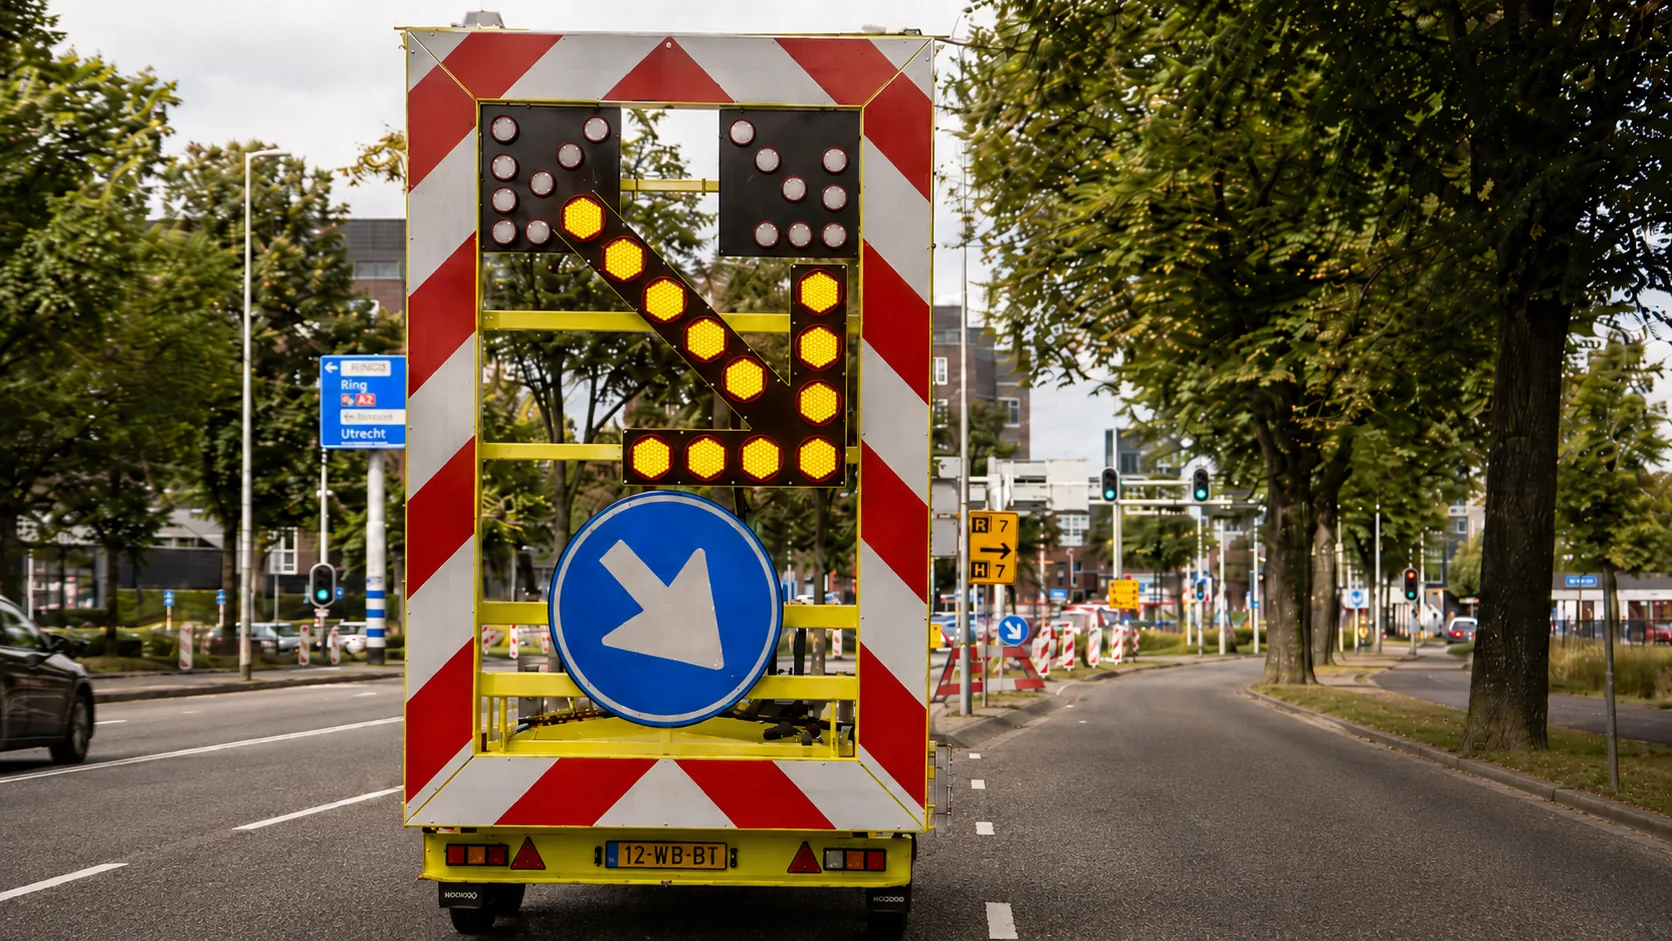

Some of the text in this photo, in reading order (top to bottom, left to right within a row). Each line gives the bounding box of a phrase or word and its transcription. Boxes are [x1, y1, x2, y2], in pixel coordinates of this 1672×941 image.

[341, 380, 367, 393] Ring
[358, 396, 374, 405] A2
[341, 428, 386, 439] Utrecht
[975, 519, 1008, 532] R 7
[975, 564, 1005, 578] H 7
[625, 845, 718, 865] 12-WB-BT
